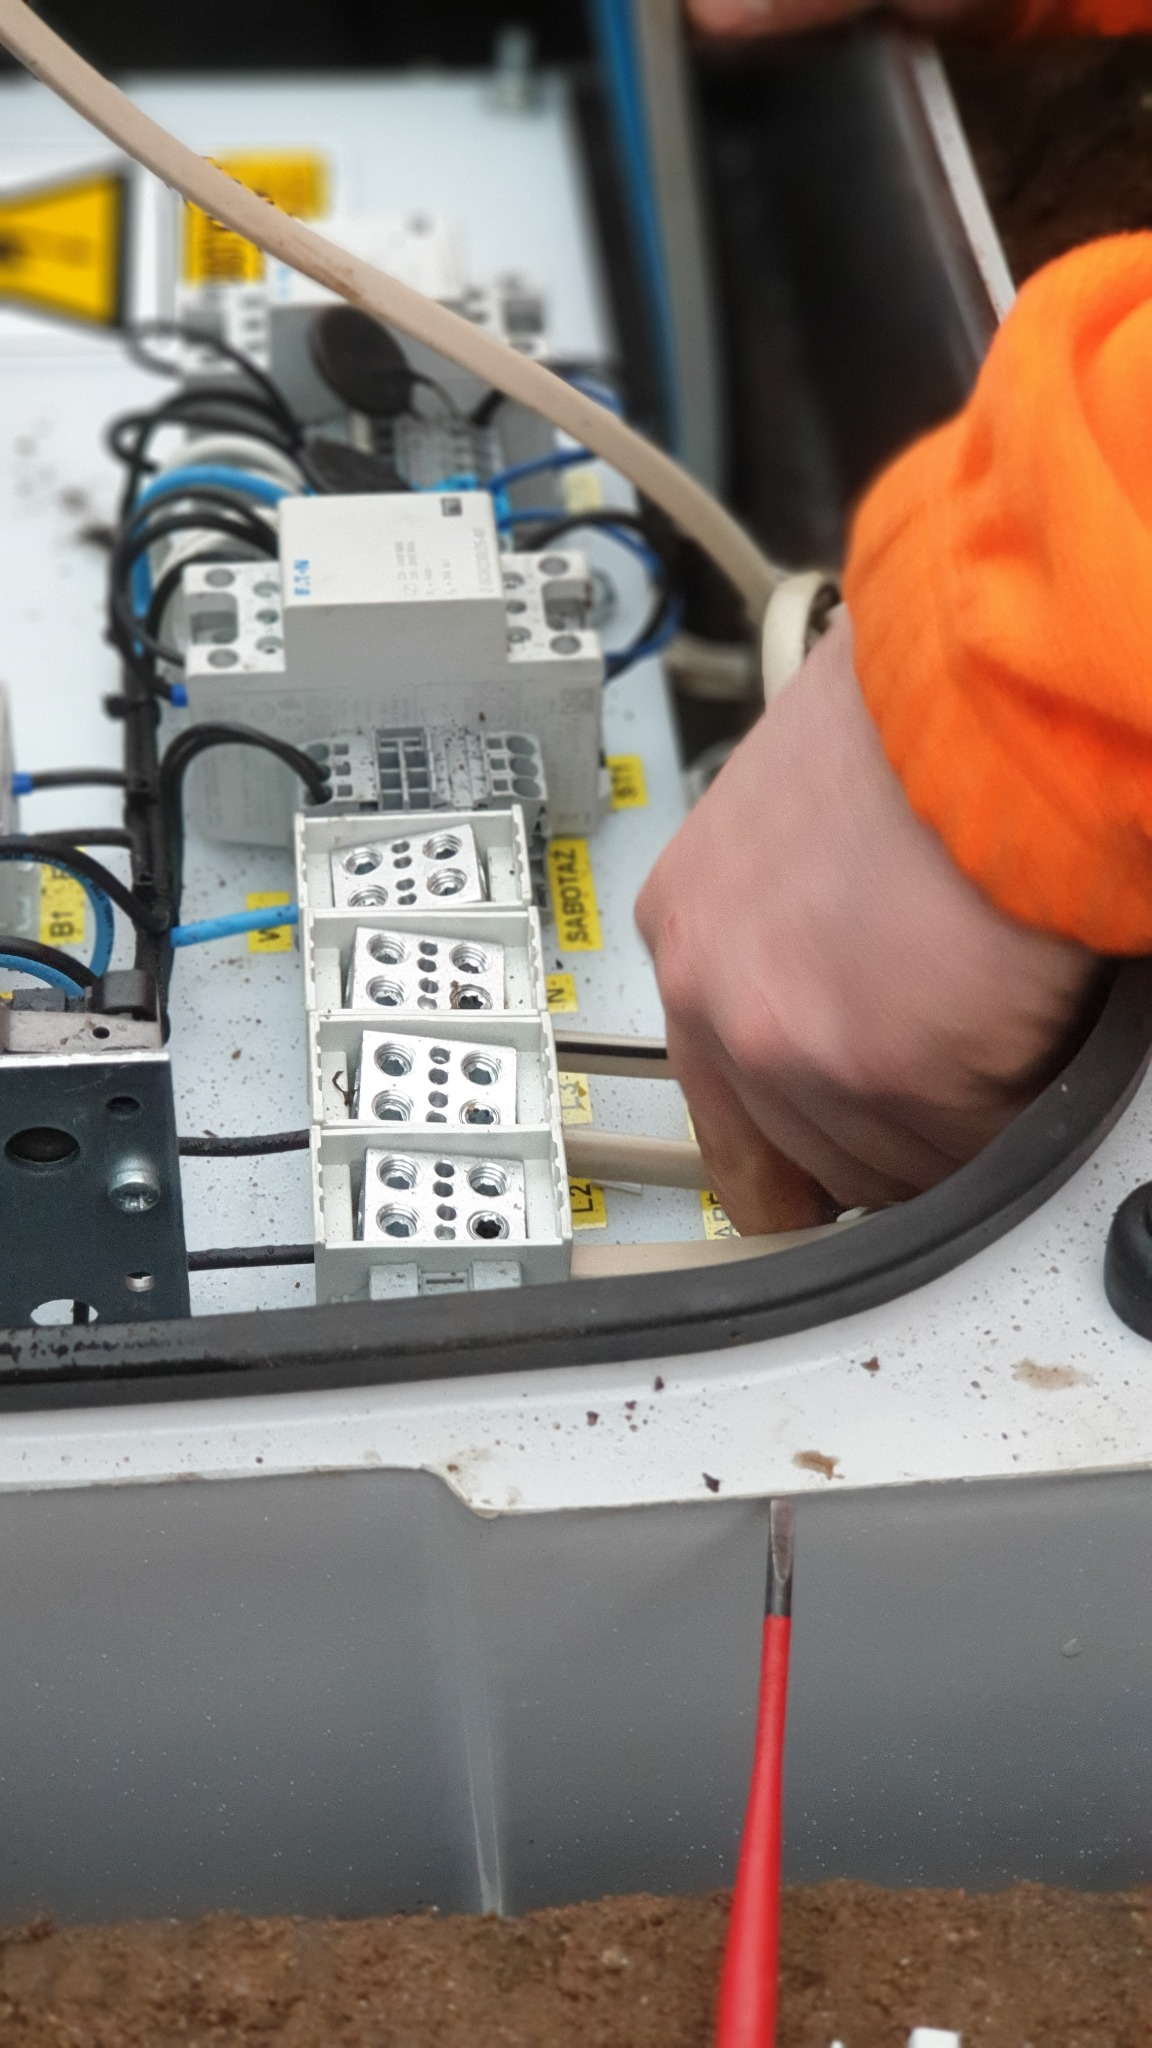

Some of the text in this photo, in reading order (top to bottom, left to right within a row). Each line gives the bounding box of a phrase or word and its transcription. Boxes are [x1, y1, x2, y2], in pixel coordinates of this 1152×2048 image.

[547, 987, 565, 1004] N
[559, 1082, 581, 1110] L3
[569, 1182, 594, 1213] L2
